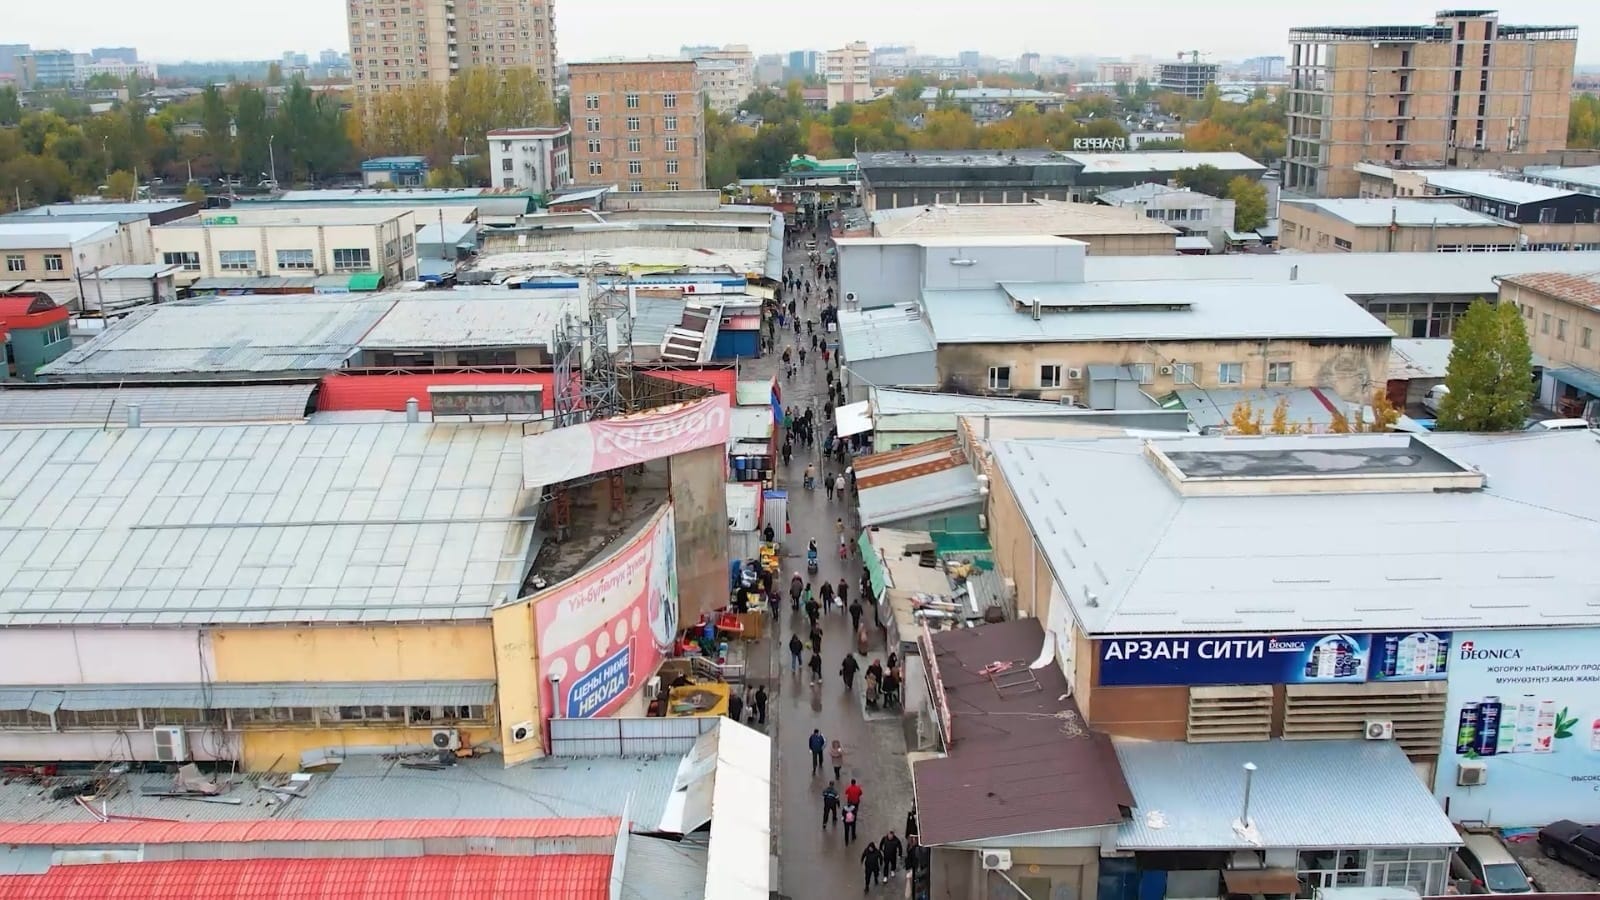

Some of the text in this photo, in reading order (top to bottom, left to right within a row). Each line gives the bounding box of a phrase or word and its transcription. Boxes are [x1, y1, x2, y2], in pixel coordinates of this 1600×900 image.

[596, 404, 726, 454] caravan
[1104, 640, 1265, 660] АРЗАН СИТИ
[1268, 640, 1306, 649] DEONICA
[1461, 648, 1521, 660] DEONICA
[1487, 665, 1524, 673] ЖОГОРКУ
[1525, 664, 1580, 673] НАТЫЙЖАЛУУ
[573, 653, 629, 702] ЦЕНЫ НИЖЕ
[1551, 675, 1574, 683] ЖАНА
[578, 671, 625, 717] НЕКУДА
